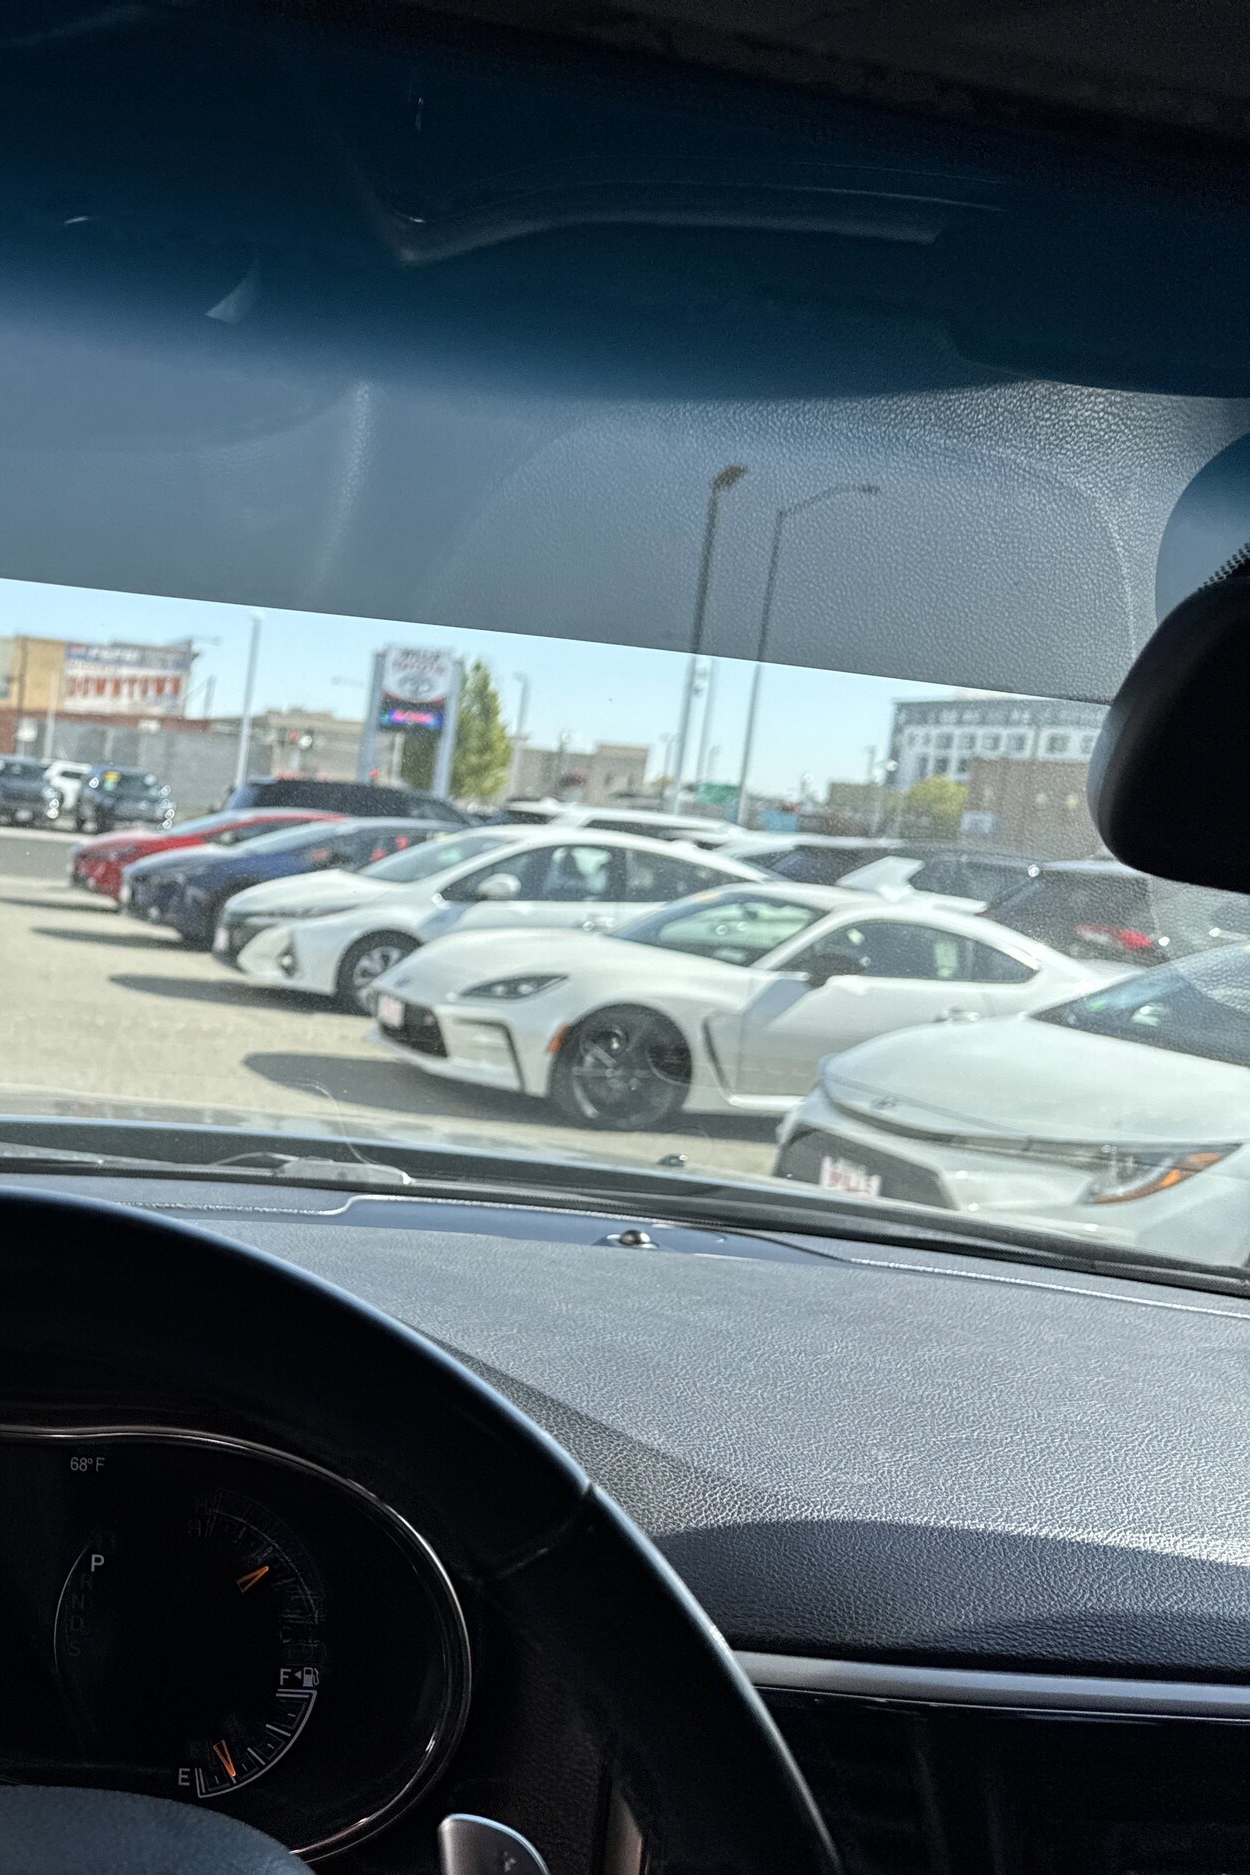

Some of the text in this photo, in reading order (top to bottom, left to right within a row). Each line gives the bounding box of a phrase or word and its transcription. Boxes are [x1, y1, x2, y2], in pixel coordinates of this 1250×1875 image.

[90, 1553, 105, 1573] P
[279, 1667, 292, 1686] F
[177, 1767, 191, 1787] E
